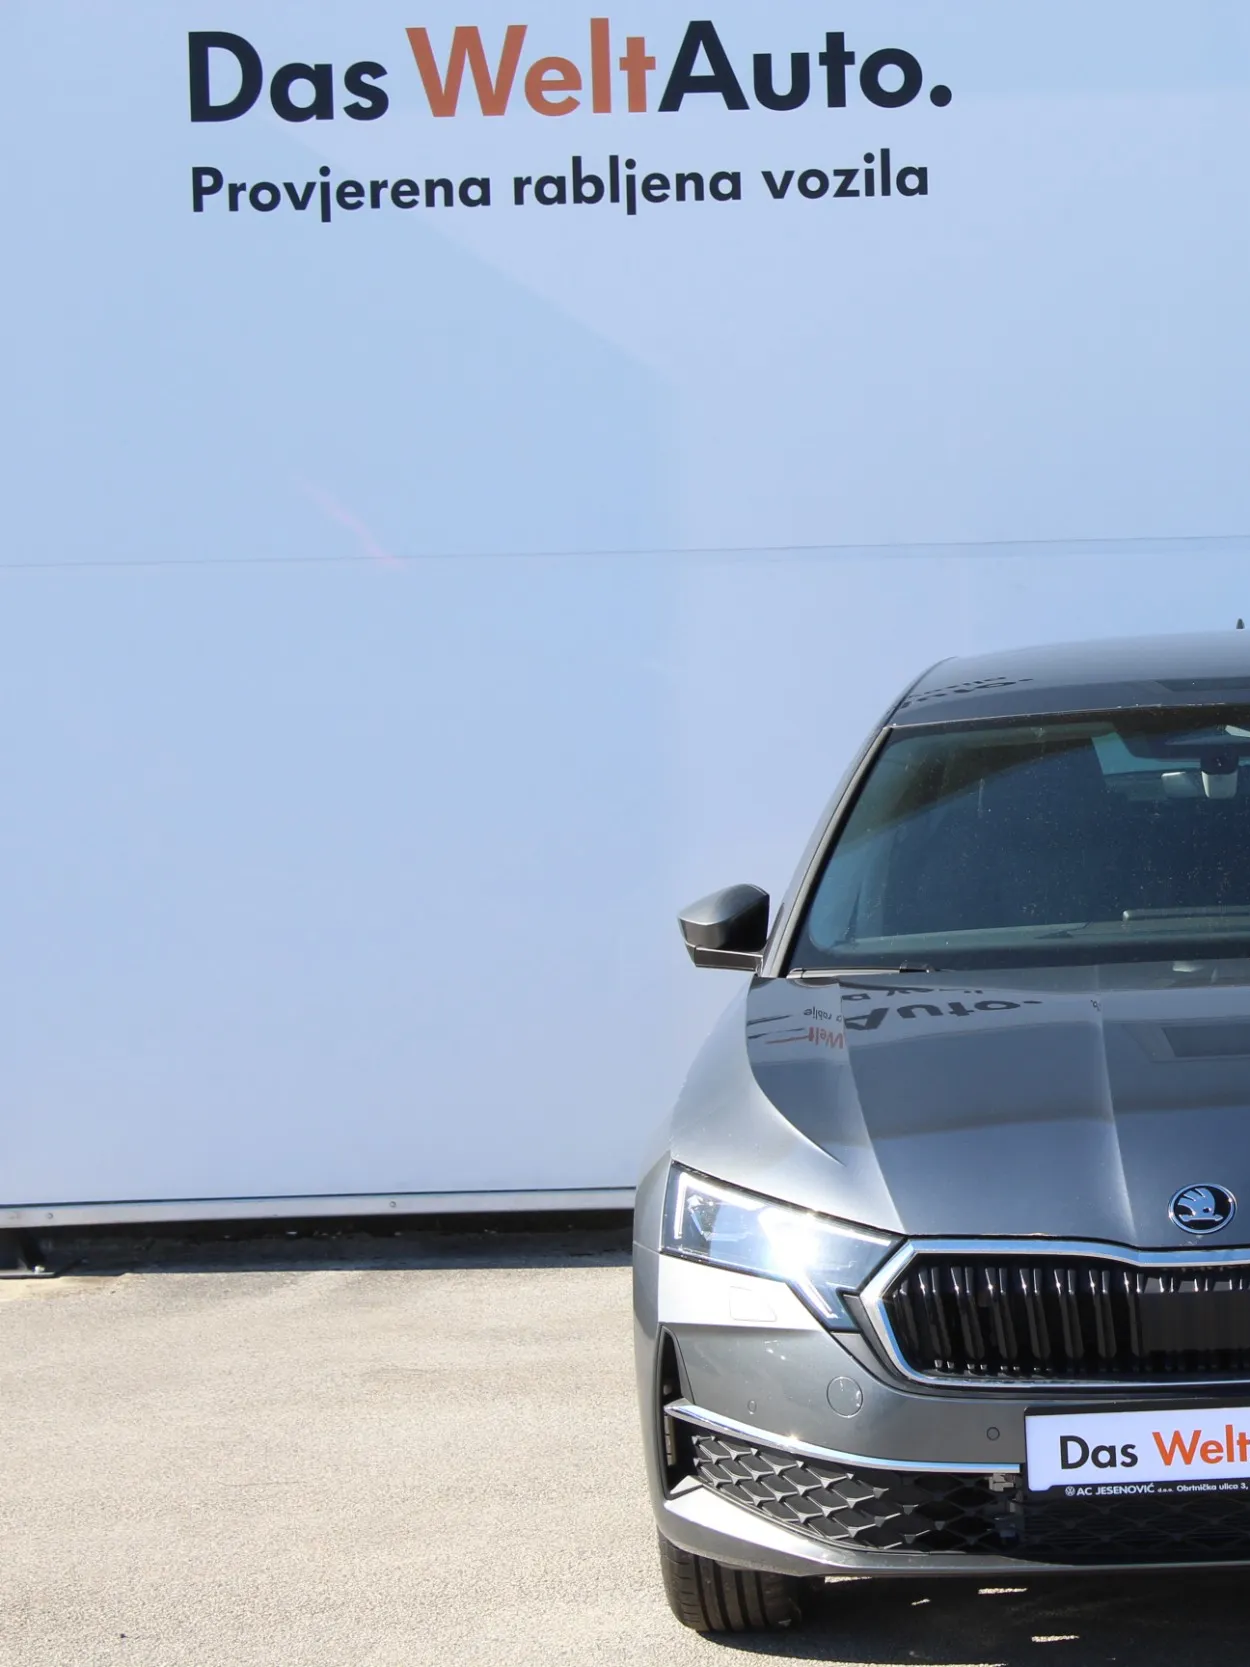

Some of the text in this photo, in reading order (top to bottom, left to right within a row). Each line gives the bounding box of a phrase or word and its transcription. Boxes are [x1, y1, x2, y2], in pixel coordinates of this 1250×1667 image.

[188, 18, 953, 123] Das WeltAuto.
[191, 148, 929, 223] Provjerena rabljena vozila
[1059, 1434, 1139, 1470] Das
[1076, 1487, 1093, 1496] AC
[1095, 1482, 1155, 1496] JESENOVIĆ
[1176, 1483, 1217, 1493] Obrtnička
[1218, 1482, 1239, 1491] ulica
[1240, 1481, 1249, 1491] 3,
